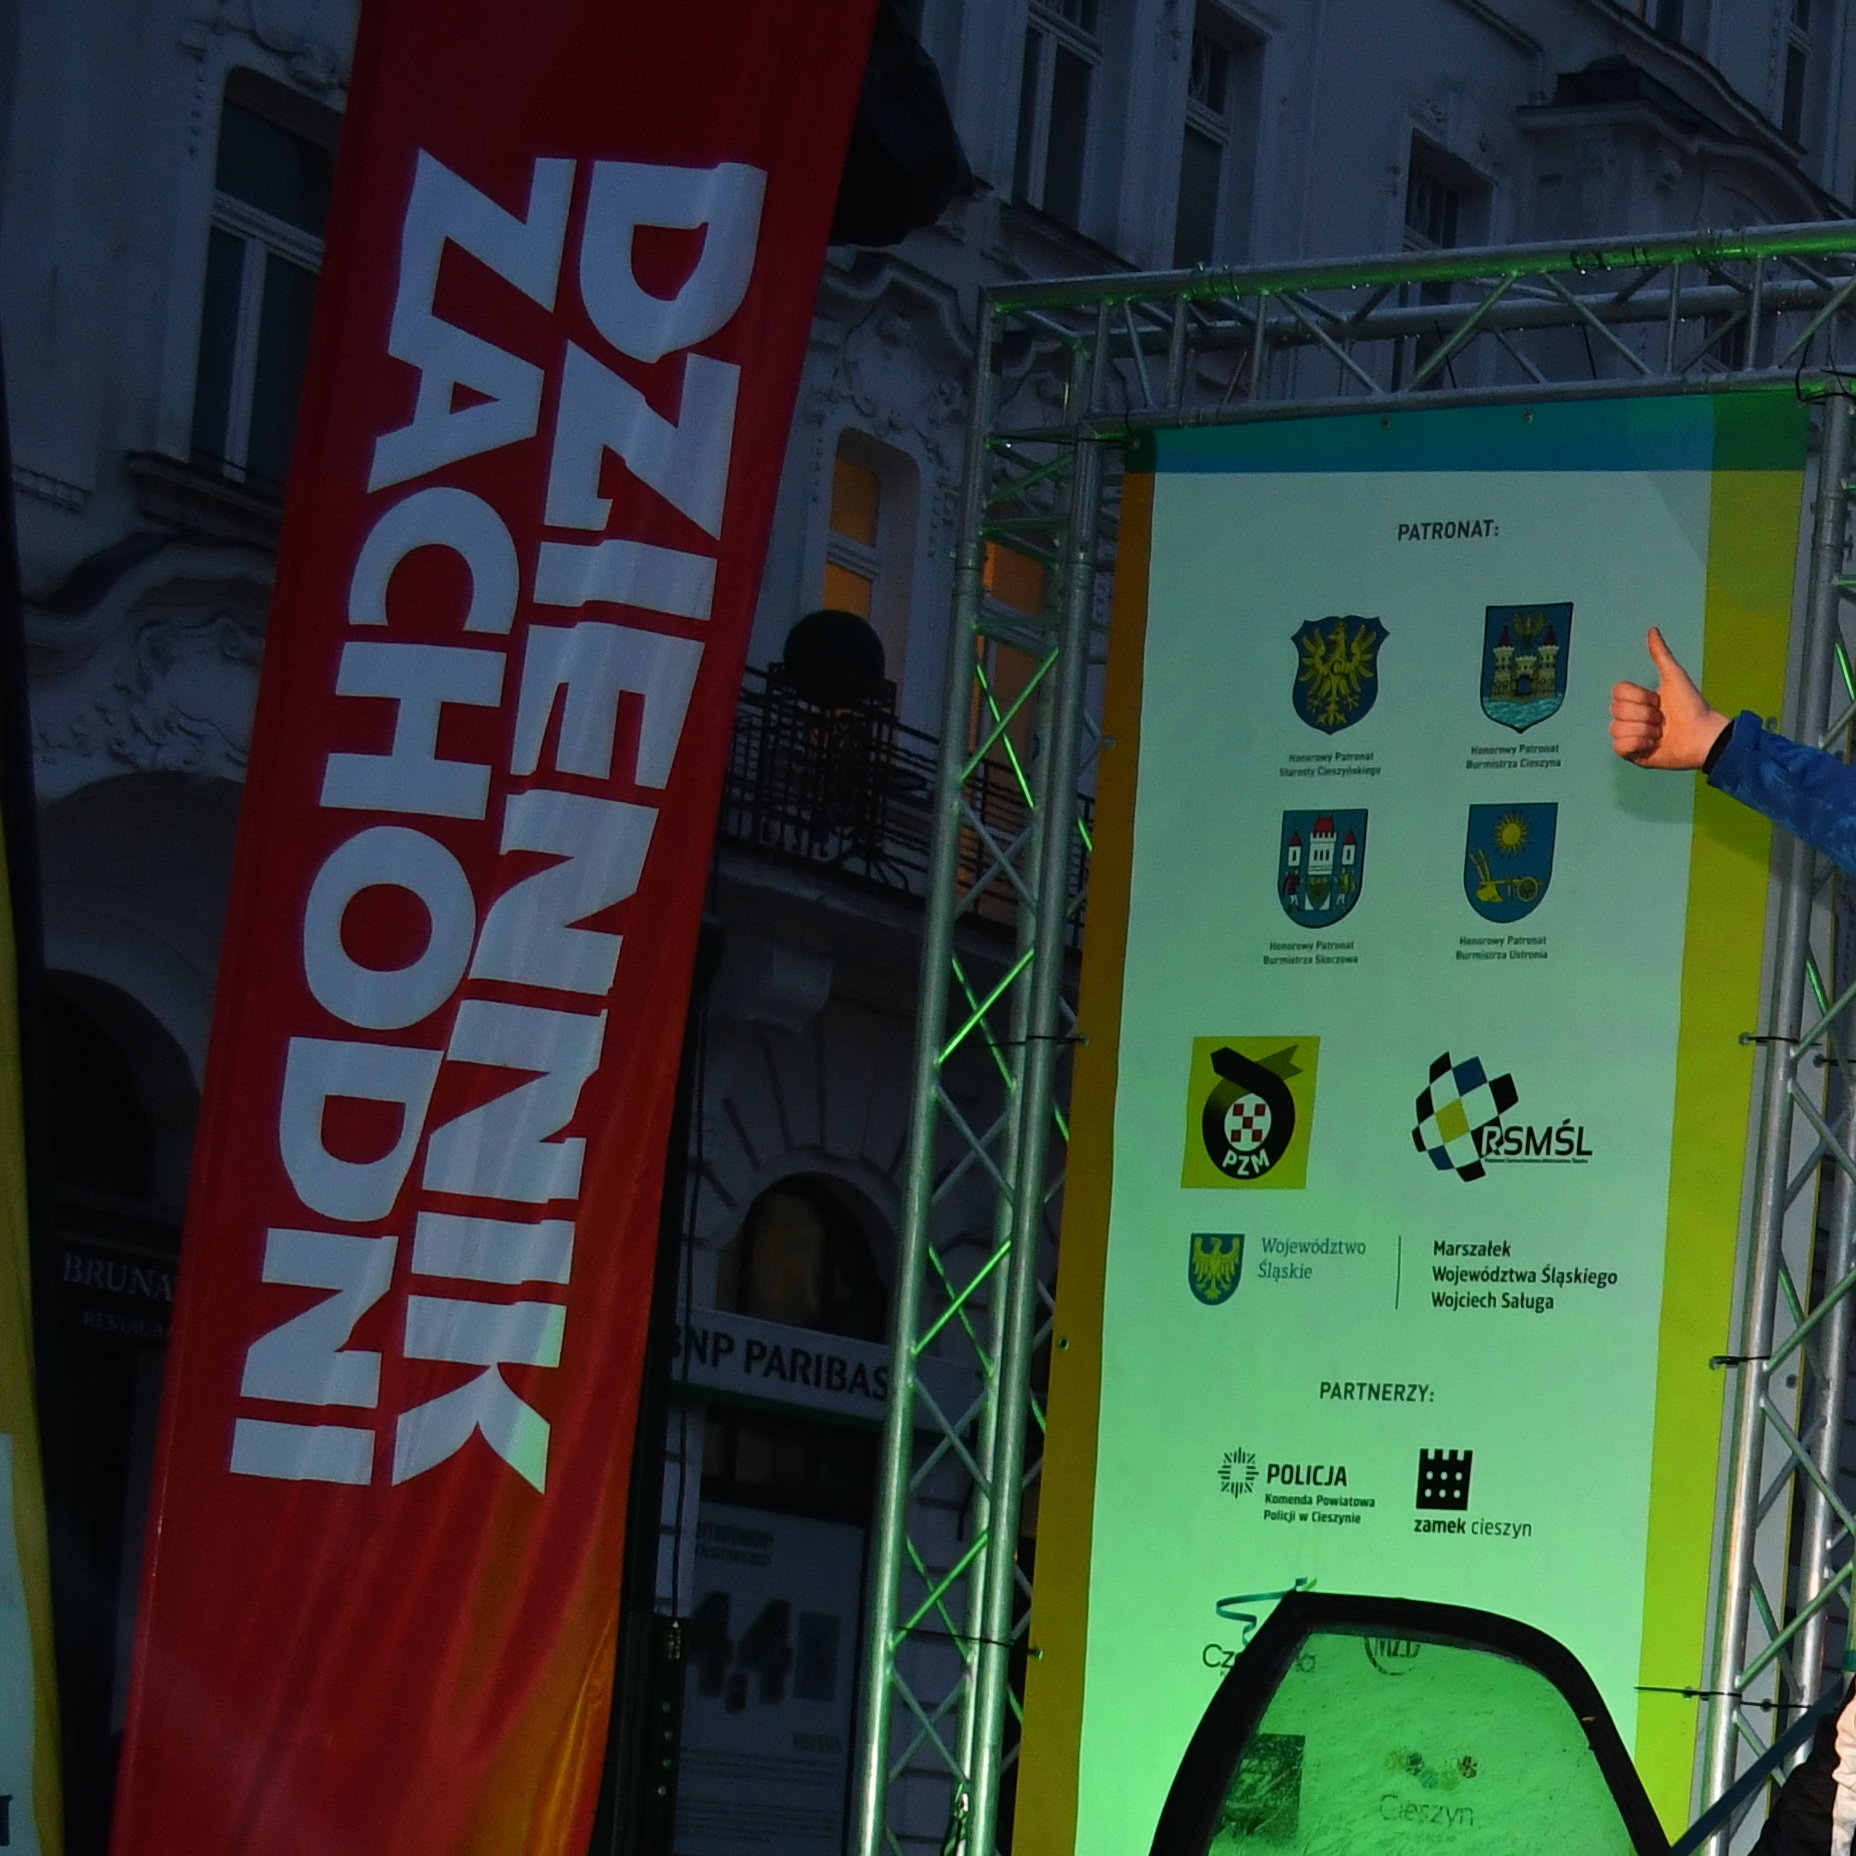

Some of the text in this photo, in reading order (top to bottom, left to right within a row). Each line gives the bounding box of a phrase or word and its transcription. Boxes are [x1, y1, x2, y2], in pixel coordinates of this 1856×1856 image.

[1398, 519, 1500, 541] PATRONAT:
[230, 147, 577, 1486] ZACHODNI
[392, 160, 768, 1494] DZIENNIK
[1222, 1150, 1271, 1177] PZM
[1261, 1236, 1367, 1258] Województwo
[1433, 1239, 1512, 1258] Marszałek
[63, 1252, 177, 1303] BRUNA
[1257, 1261, 1313, 1283] Śląskie
[1431, 1264, 1618, 1288] Województwa Śląskiego
[1431, 1291, 1555, 1314] Wojciech Saługa
[744, 1339, 890, 1402] PARIBAS
[1319, 1381, 1435, 1403] PARTNERZY:
[1266, 1463, 1348, 1487] POLICJA
[1264, 1493, 1376, 1508] Komenda Powiatowa
[1263, 1510, 1296, 1523] Policji
[1312, 1511, 1362, 1525] Cieszynie
[1414, 1517, 1533, 1540] zamek cieszyn
